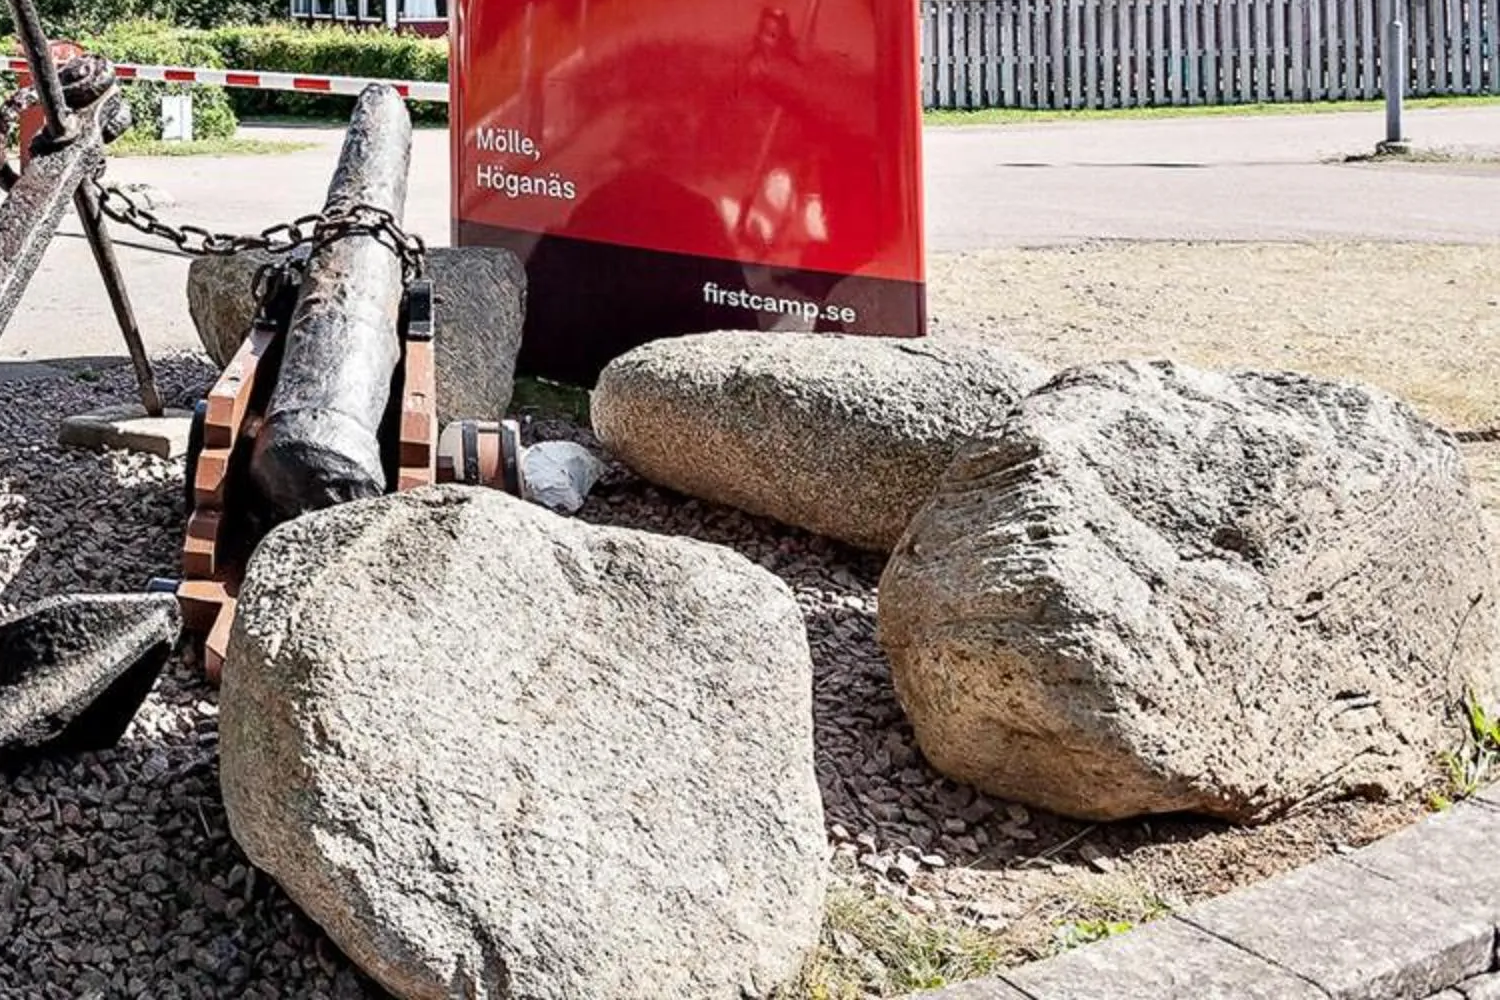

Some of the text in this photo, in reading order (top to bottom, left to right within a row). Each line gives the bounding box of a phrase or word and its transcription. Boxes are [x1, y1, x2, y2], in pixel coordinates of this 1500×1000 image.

[476, 126, 541, 160] Mölle,
[476, 164, 576, 199] Höganäs
[702, 281, 856, 324] firstcamp.se
